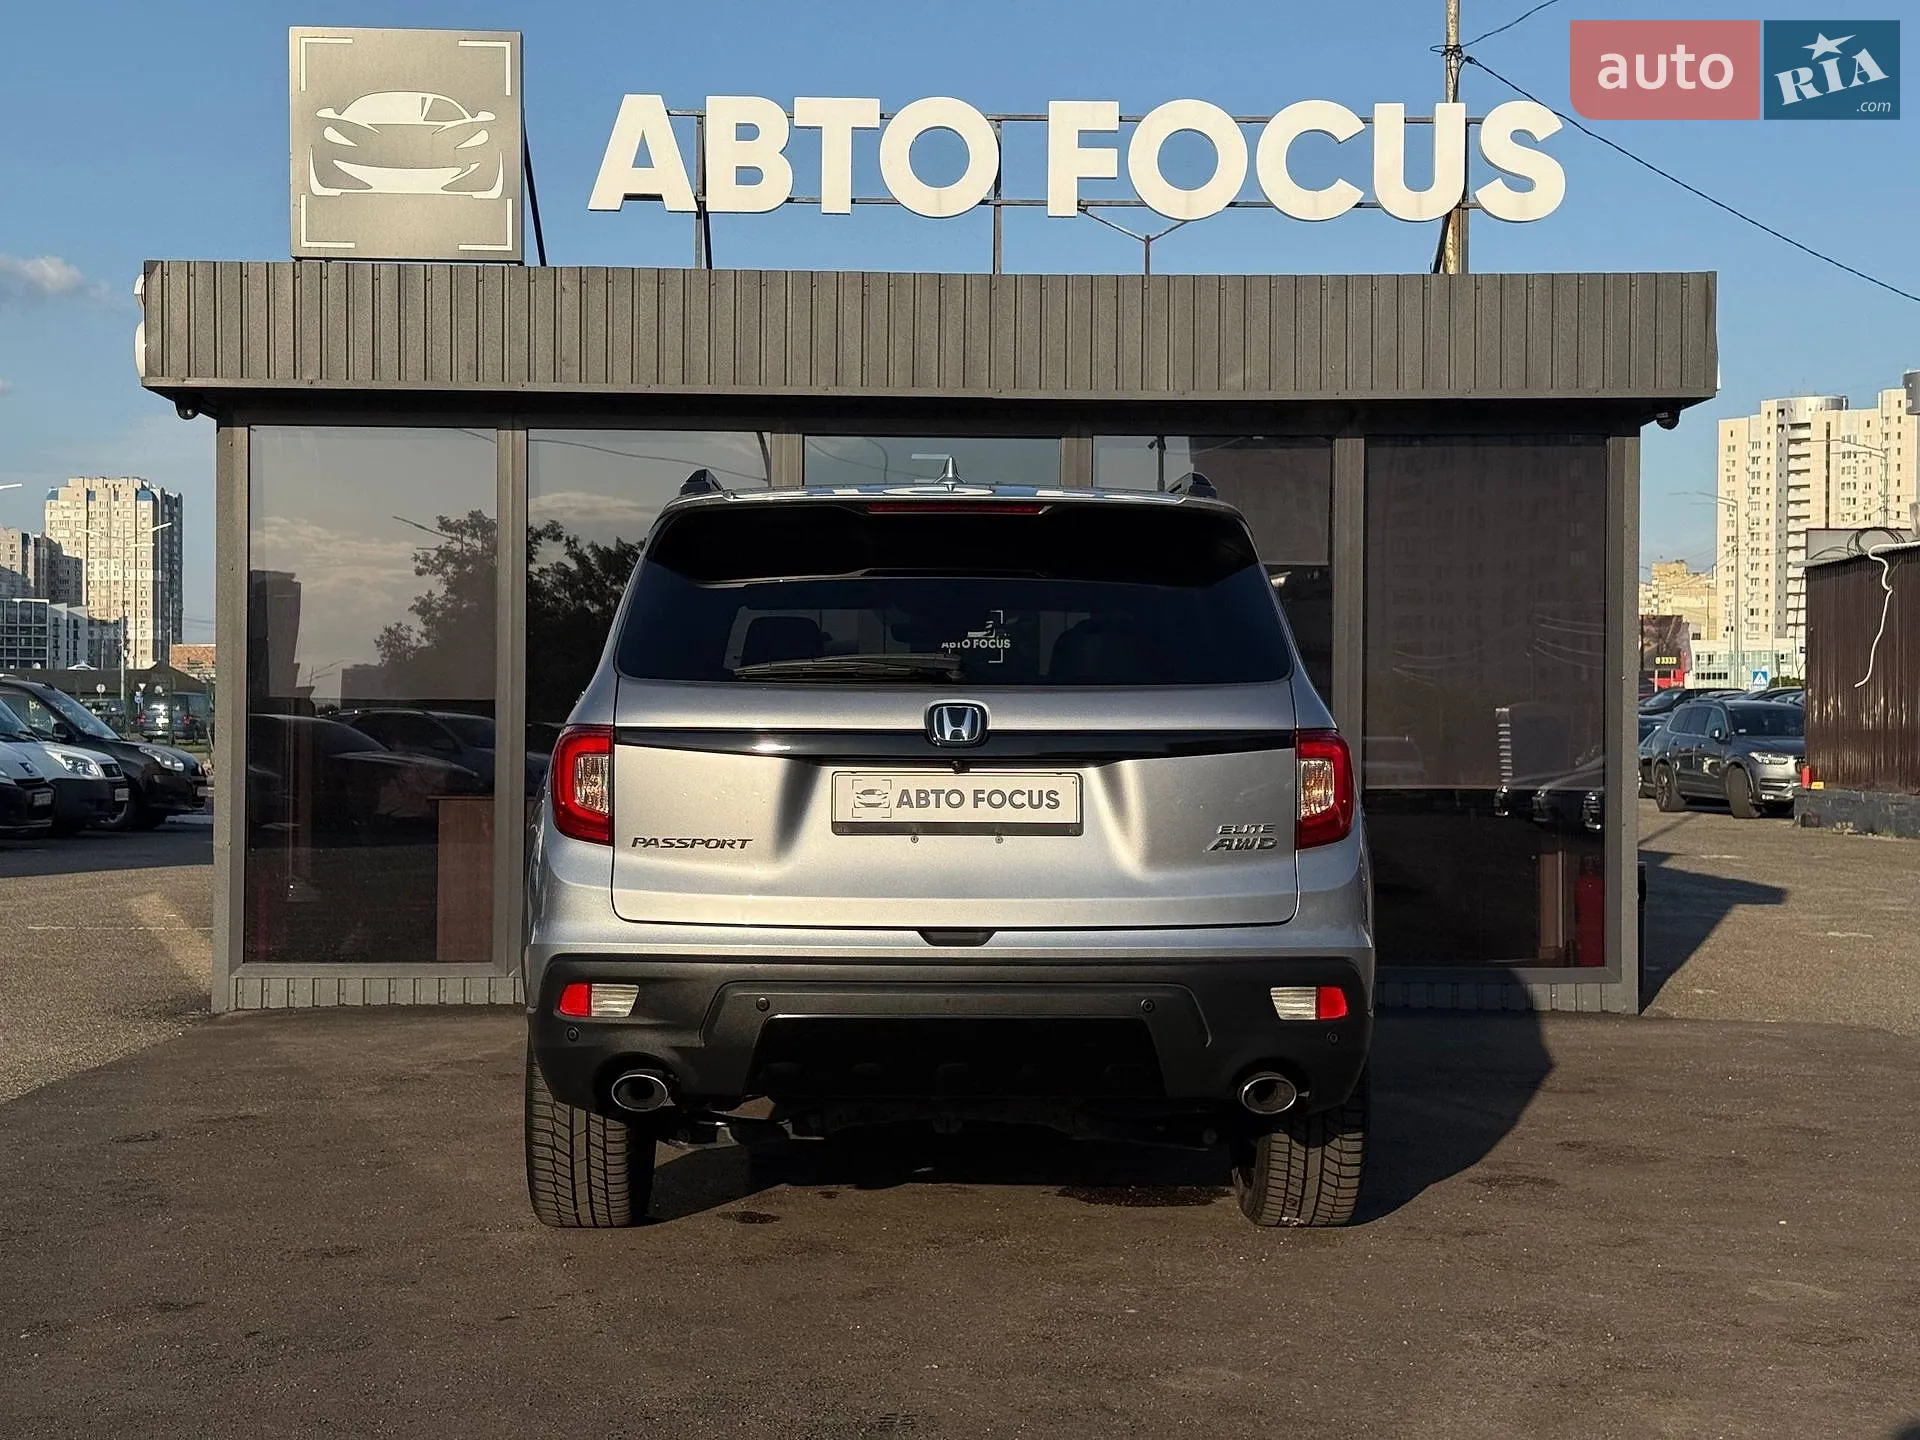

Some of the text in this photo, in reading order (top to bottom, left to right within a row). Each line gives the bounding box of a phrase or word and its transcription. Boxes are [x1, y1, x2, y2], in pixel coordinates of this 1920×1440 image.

[1047, 98, 1566, 222] FOCUS
[973, 639, 1011, 649] FOCUS
[973, 788, 1061, 810] FOCUS
[1216, 824, 1277, 835] ELITE
[631, 837, 753, 849] PASSPORT
[1207, 837, 1278, 851] AWD
